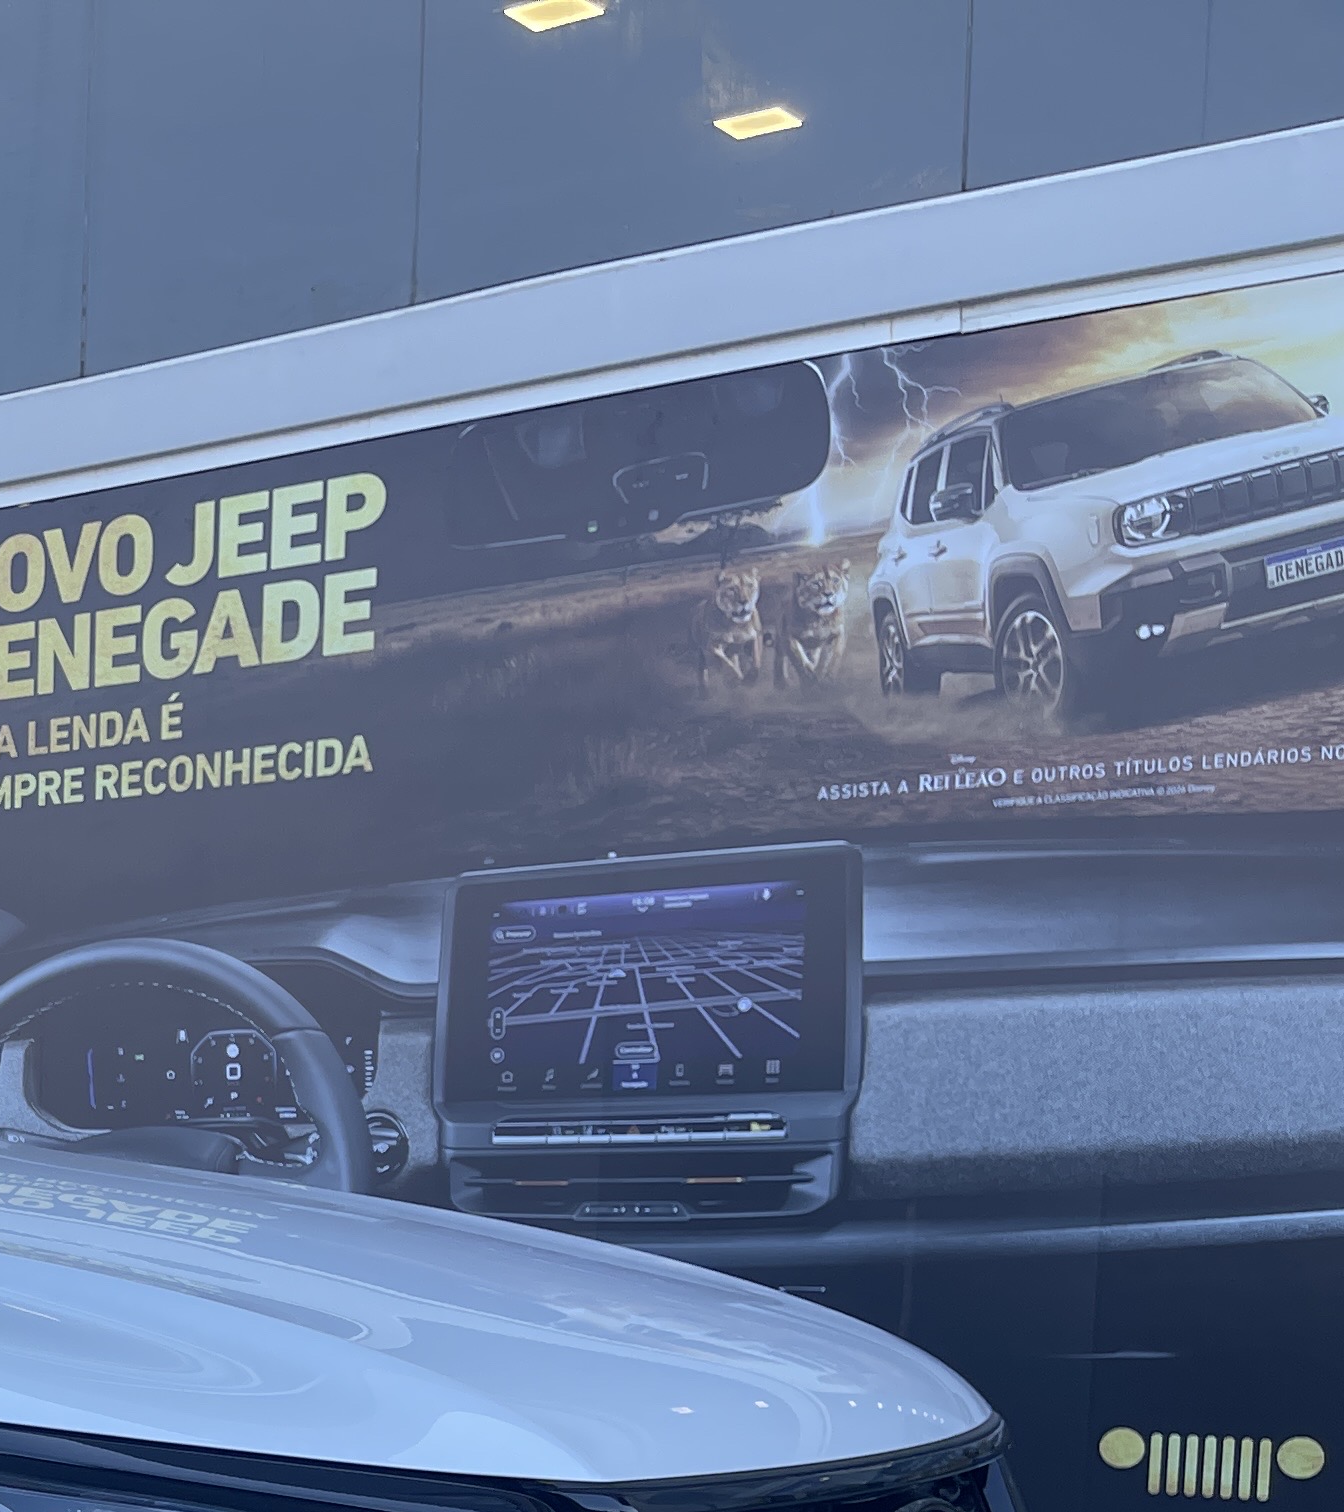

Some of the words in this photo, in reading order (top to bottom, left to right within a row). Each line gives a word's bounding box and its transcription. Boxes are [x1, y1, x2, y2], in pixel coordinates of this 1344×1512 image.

[166, 472, 388, 587] JEEP
[27, 707, 151, 756] LENDA
[161, 693, 185, 740] É
[95, 734, 373, 801] RECONHECIDA
[816, 780, 891, 801] ASSISTA
[897, 779, 909, 794] A
[1013, 768, 1024, 785] E
[1032, 764, 1106, 784] OUTROS
[1113, 754, 1194, 778] TÍTULOS
[1202, 745, 1312, 770] LENDÁRIOS
